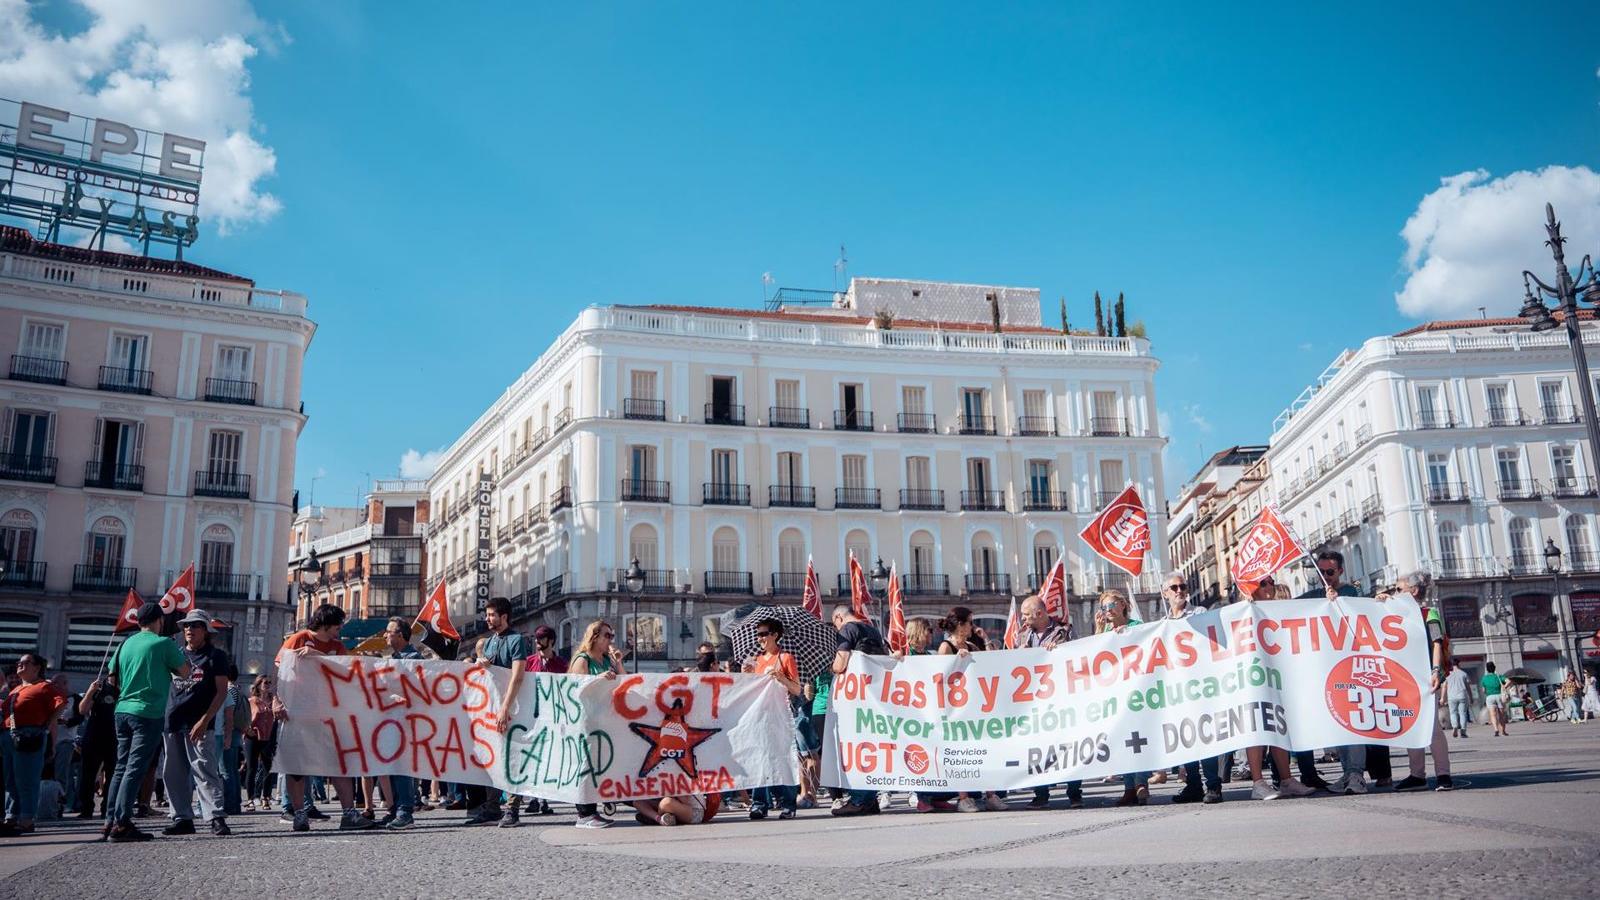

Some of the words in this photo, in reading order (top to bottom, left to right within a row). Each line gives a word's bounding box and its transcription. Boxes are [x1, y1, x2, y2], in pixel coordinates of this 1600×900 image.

[15, 158, 199, 204] EMBOTELLADO
[479, 480, 492, 540] HOTEL
[1104, 508, 1147, 550] UGT
[1239, 527, 1272, 568] UGT
[320, 658, 489, 711] MENOS
[880, 671, 927, 709] las
[932, 671, 968, 709] 18
[978, 676, 1000, 713] y
[1011, 664, 1056, 703] 23
[1066, 630, 1198, 695] HORAS
[1207, 614, 1408, 661] LECTIVAS
[1352, 657, 1386, 676] UGT
[533, 675, 581, 724] MÁS
[613, 676, 734, 720] CGT
[856, 708, 935, 740] Mayor
[942, 703, 1076, 740] inversión
[1085, 695, 1118, 723] en
[1127, 658, 1282, 712] educación
[1347, 686, 1402, 734] 35
[1391, 709, 1414, 717] HORAS
[324, 712, 495, 778] HORAS
[505, 723, 614, 788] CALIDAD
[660, 748, 685, 759] CGT
[839, 742, 896, 773] UGT
[944, 747, 987, 757] Servicios
[1028, 733, 1111, 775] RATIOS
[1162, 701, 1288, 754] DOCENTES
[865, 775, 897, 787] Sector
[898, 776, 948, 788] Enseñanza
[943, 756, 984, 767] Públicos
[944, 768, 980, 780] Madrid
